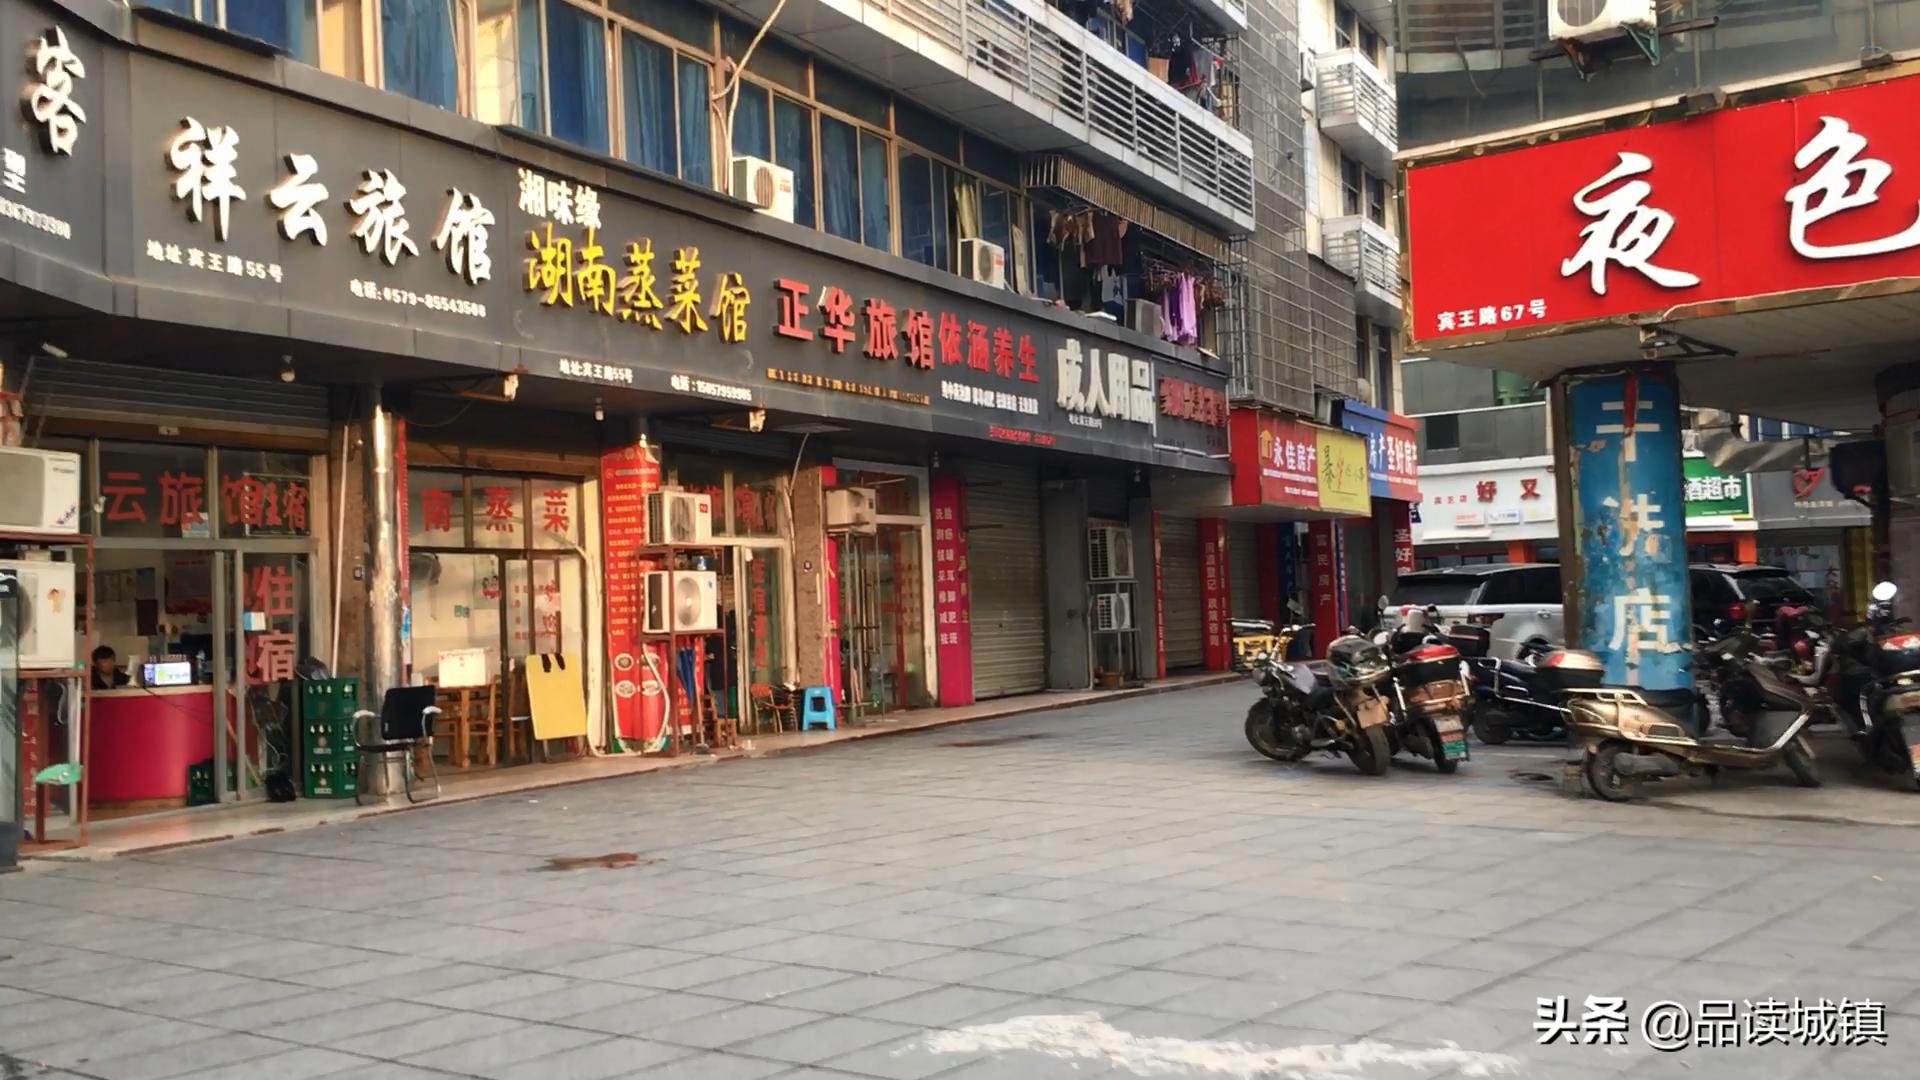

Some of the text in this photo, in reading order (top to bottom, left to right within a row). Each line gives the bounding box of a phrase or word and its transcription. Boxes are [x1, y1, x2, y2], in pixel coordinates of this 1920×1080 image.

[31, 25, 86, 156] 客
[168, 116, 496, 285] 祥云旅馆
[518, 167, 601, 229] 湘味缘
[1561, 116, 1920, 295] 夜色
[527, 222, 751, 343] 湖南蒸菜馆
[776, 278, 935, 370] 正华旅馆
[1437, 299, 1548, 332] 宾王路67号
[938, 311, 1040, 383] 依涵养生
[1056, 338, 1155, 424] 成人用品
[420, 485, 569, 533] 南蒸菜
[257, 564, 297, 682] 住宿
